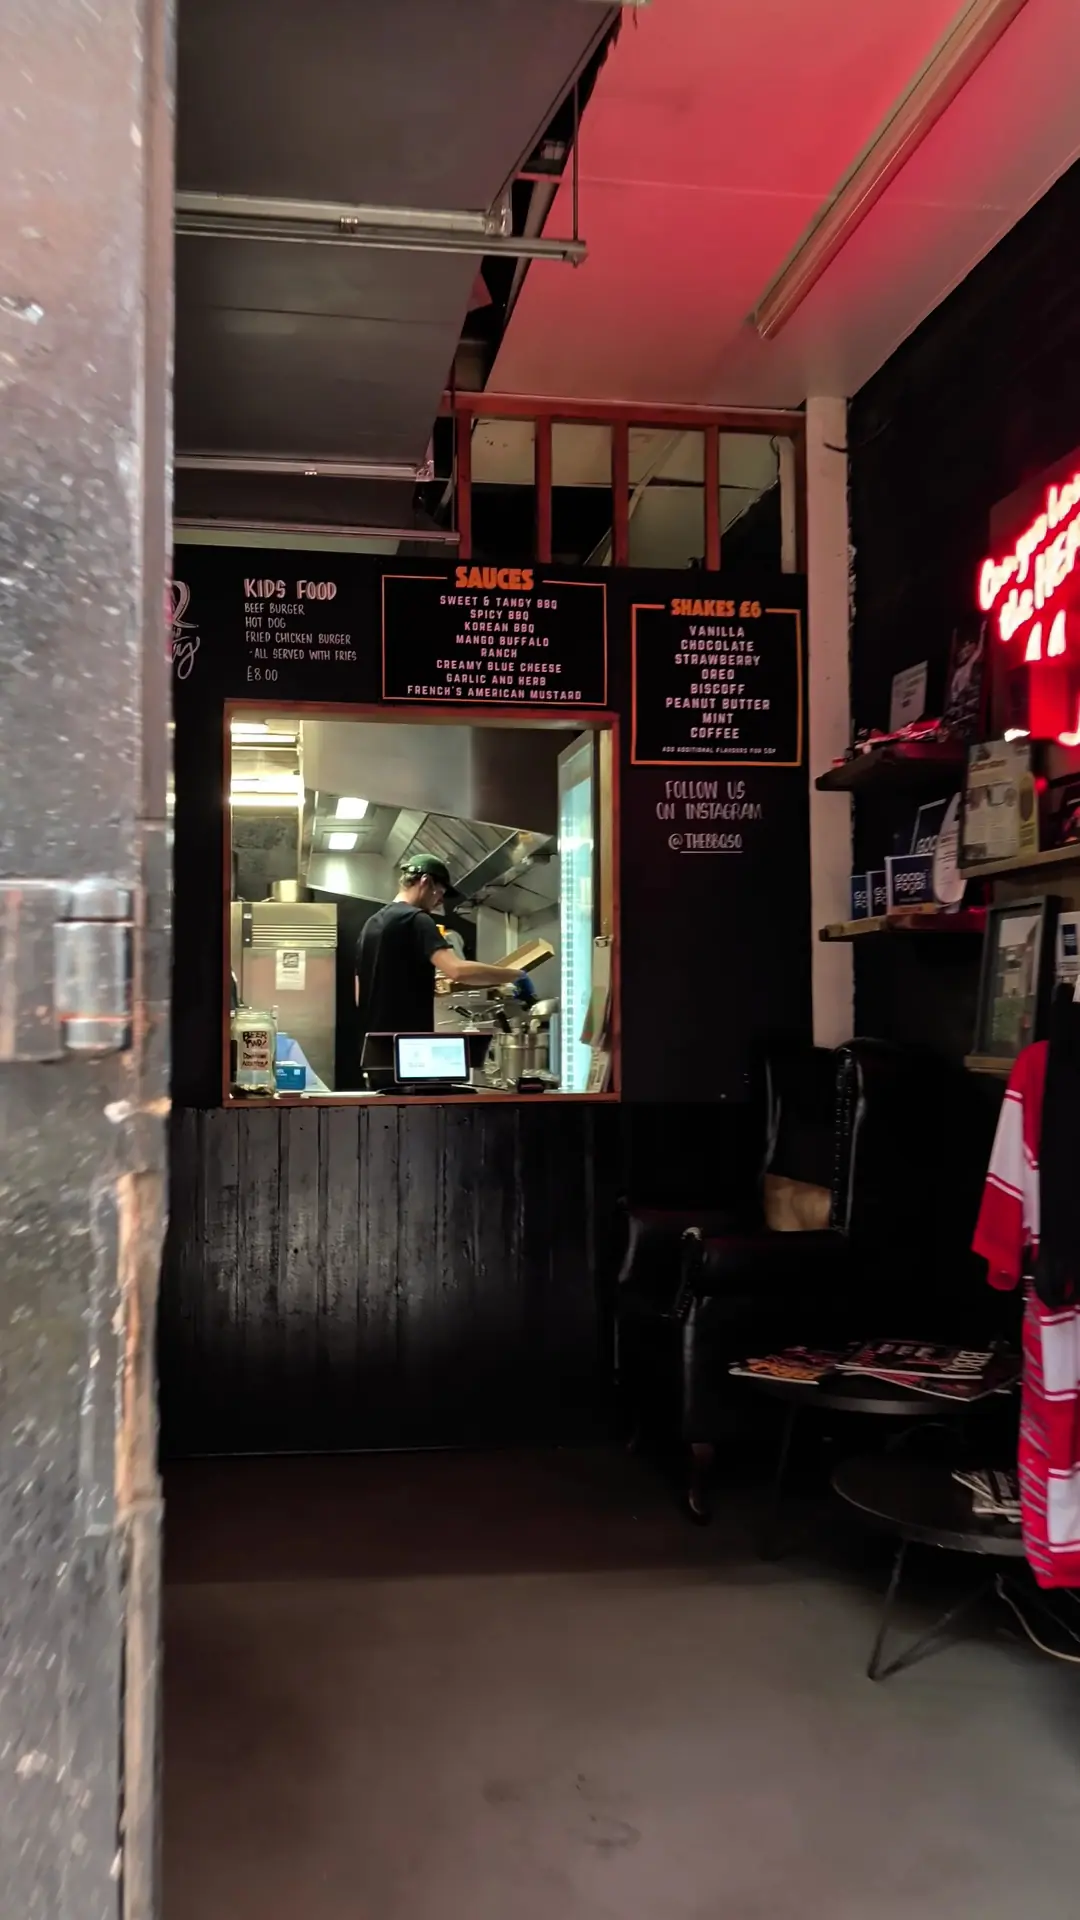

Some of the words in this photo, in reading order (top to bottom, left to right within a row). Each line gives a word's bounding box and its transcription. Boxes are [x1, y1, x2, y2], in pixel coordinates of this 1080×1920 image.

[456, 566, 534, 590] SAUCES
[244, 579, 286, 598] KIDS
[297, 580, 337, 600] FOOD
[440, 596, 477, 605] SWEET
[484, 596, 489, 606] &
[496, 598, 531, 608] TANGY
[537, 599, 557, 609] BBQ
[671, 599, 735, 617] SHAKES
[739, 601, 761, 618] £6
[245, 603, 264, 613] BEEF
[270, 603, 305, 615] BURGER
[470, 609, 502, 619] SPICY
[508, 611, 528, 620] BBQ
[245, 616, 262, 628] HOT
[268, 617, 286, 628] DOG
[464, 622, 508, 632] KOREAN
[514, 623, 534, 633] BBQ
[246, 631, 270, 642] FRIED
[276, 632, 312, 643] CHICKEN
[319, 634, 350, 644] BURGER
[689, 626, 744, 637] VANILLA
[456, 635, 494, 645] MANGO
[500, 636, 548, 646] BUFFALO
[681, 639, 754, 652] CHOCOLATE
[273, 648, 304, 659] SERVED
[309, 650, 330, 660] WITH
[335, 650, 356, 660] FRIES
[481, 648, 517, 658] RANCH
[675, 654, 760, 665] STRAWBERRY
[437, 660, 482, 670] CREAMY
[488, 662, 514, 671] BLUE
[520, 663, 561, 673] CHEESE
[447, 673, 486, 683] GARLIC
[492, 675, 513, 684] AND
[519, 676, 545, 686] HERB
[702, 669, 734, 680] OREO
[407, 685, 462, 696] FRENCH'S
[467, 688, 525, 699] AMERICAN
[530, 690, 581, 700] MUSTARD
[691, 683, 745, 694] BISCOFF
[666, 697, 716, 708] PEANUT
[722, 698, 769, 710] BUTTER
[702, 713, 733, 723] MINT
[691, 727, 739, 739] COFFEE
[665, 781, 717, 799] FOLLOW
[727, 781, 745, 799] US
[656, 802, 674, 820] ON
[685, 802, 763, 820] INSTAGRAM
